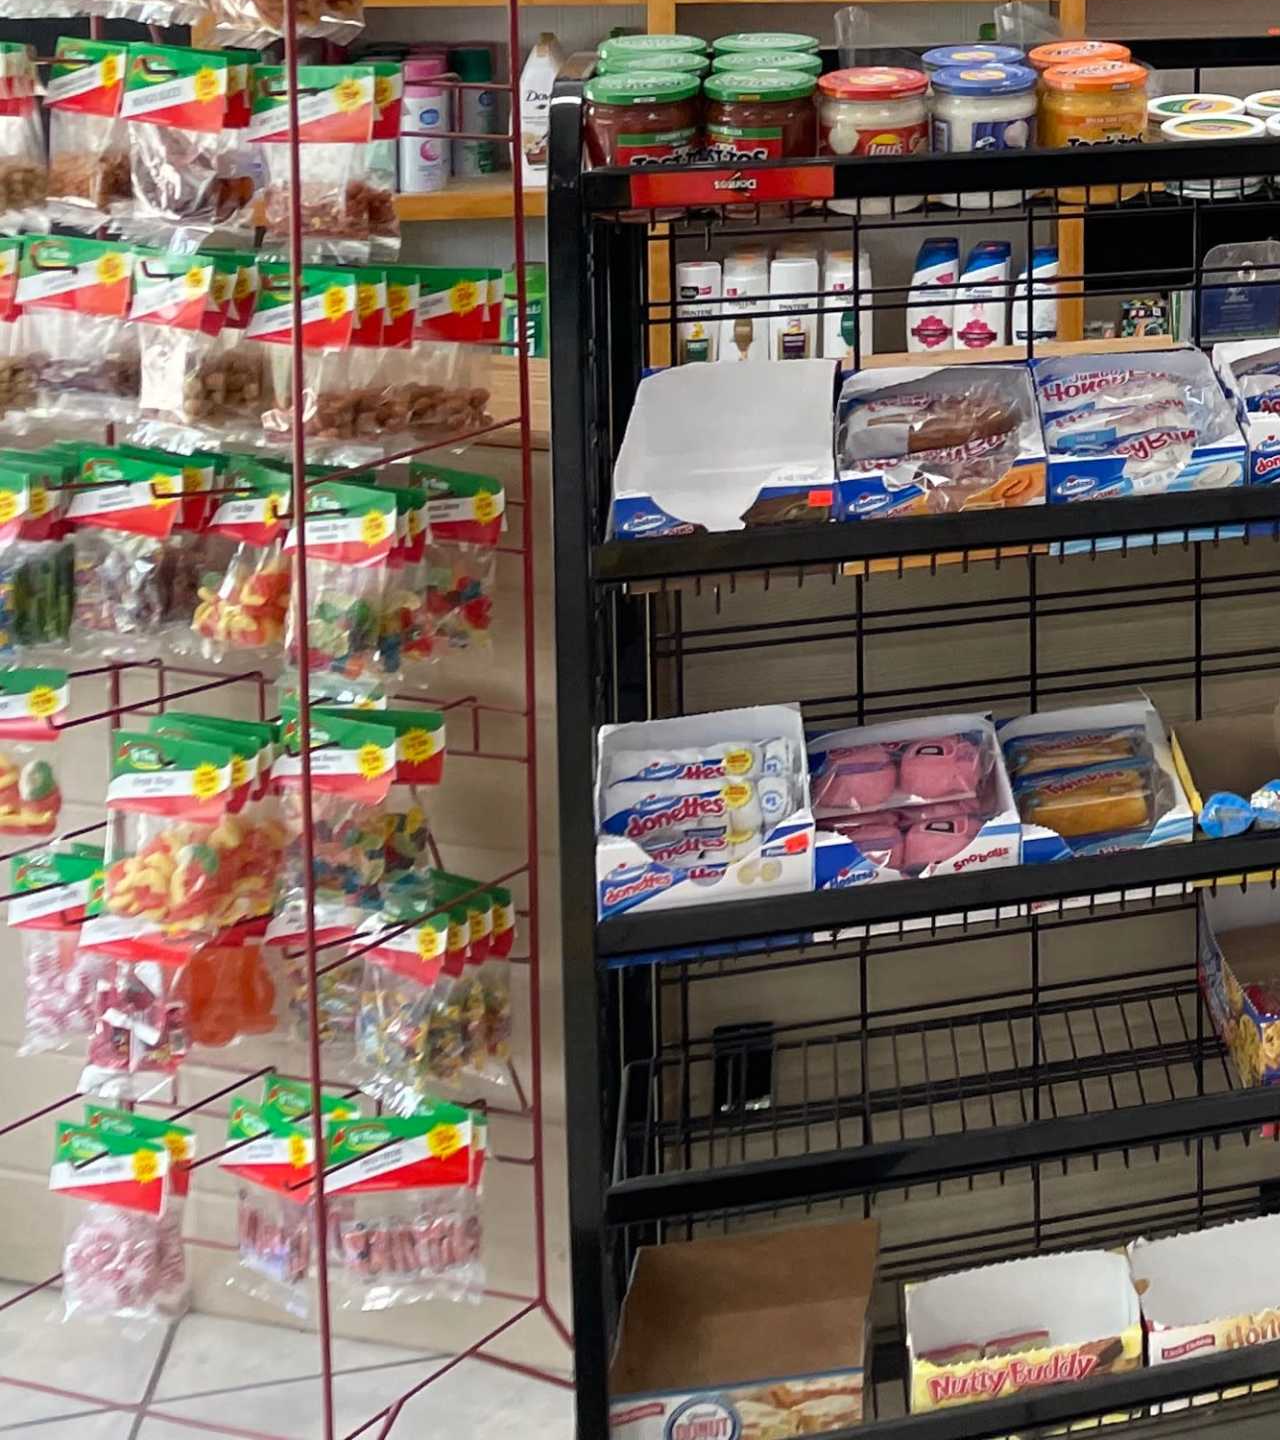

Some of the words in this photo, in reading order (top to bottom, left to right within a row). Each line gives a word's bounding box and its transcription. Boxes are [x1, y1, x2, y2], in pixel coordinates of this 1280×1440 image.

[527, 90, 551, 102] Dov
[1043, 769, 1124, 795] Twinkies
[627, 797, 725, 838] donettes
[604, 873, 673, 905] donettes
[928, 1365, 1001, 1403] Nutty
[1011, 1351, 1098, 1391] Buddy
